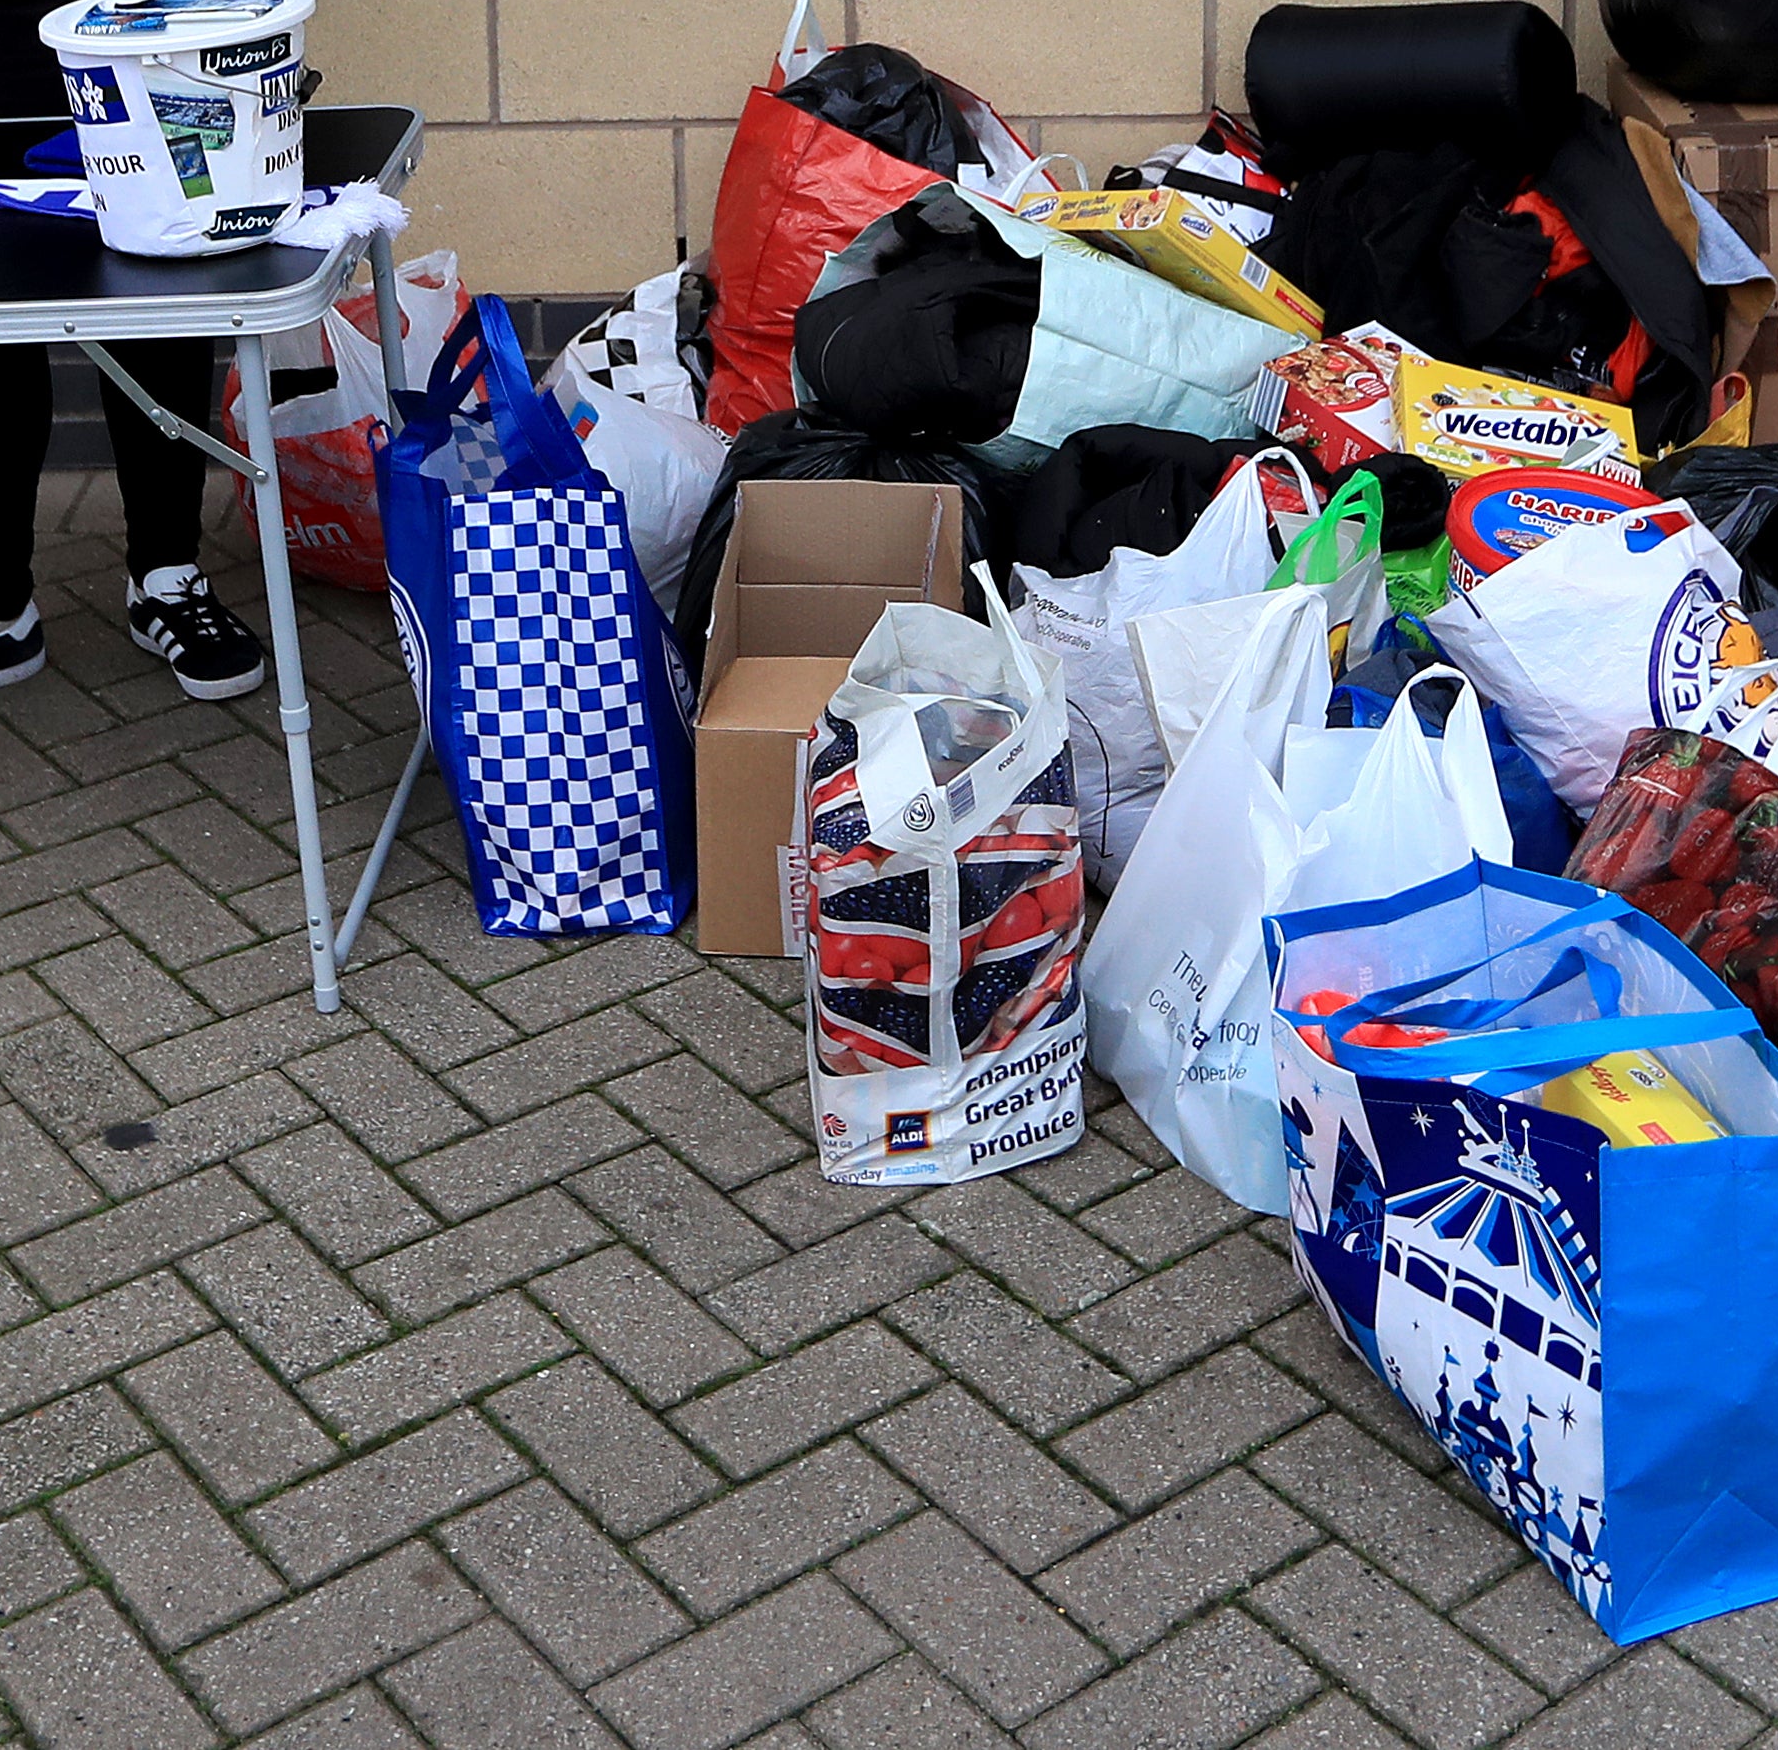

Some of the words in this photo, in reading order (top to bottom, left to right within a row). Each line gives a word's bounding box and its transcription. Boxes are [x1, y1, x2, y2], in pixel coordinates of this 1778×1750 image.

[204, 50, 271, 74] Union
[270, 35, 287, 60] FS
[94, 154, 146, 176] YOUR
[964, 1086, 1034, 1126] Great
[890, 1130, 925, 1145] ALDI
[969, 1110, 1077, 1167] produce
